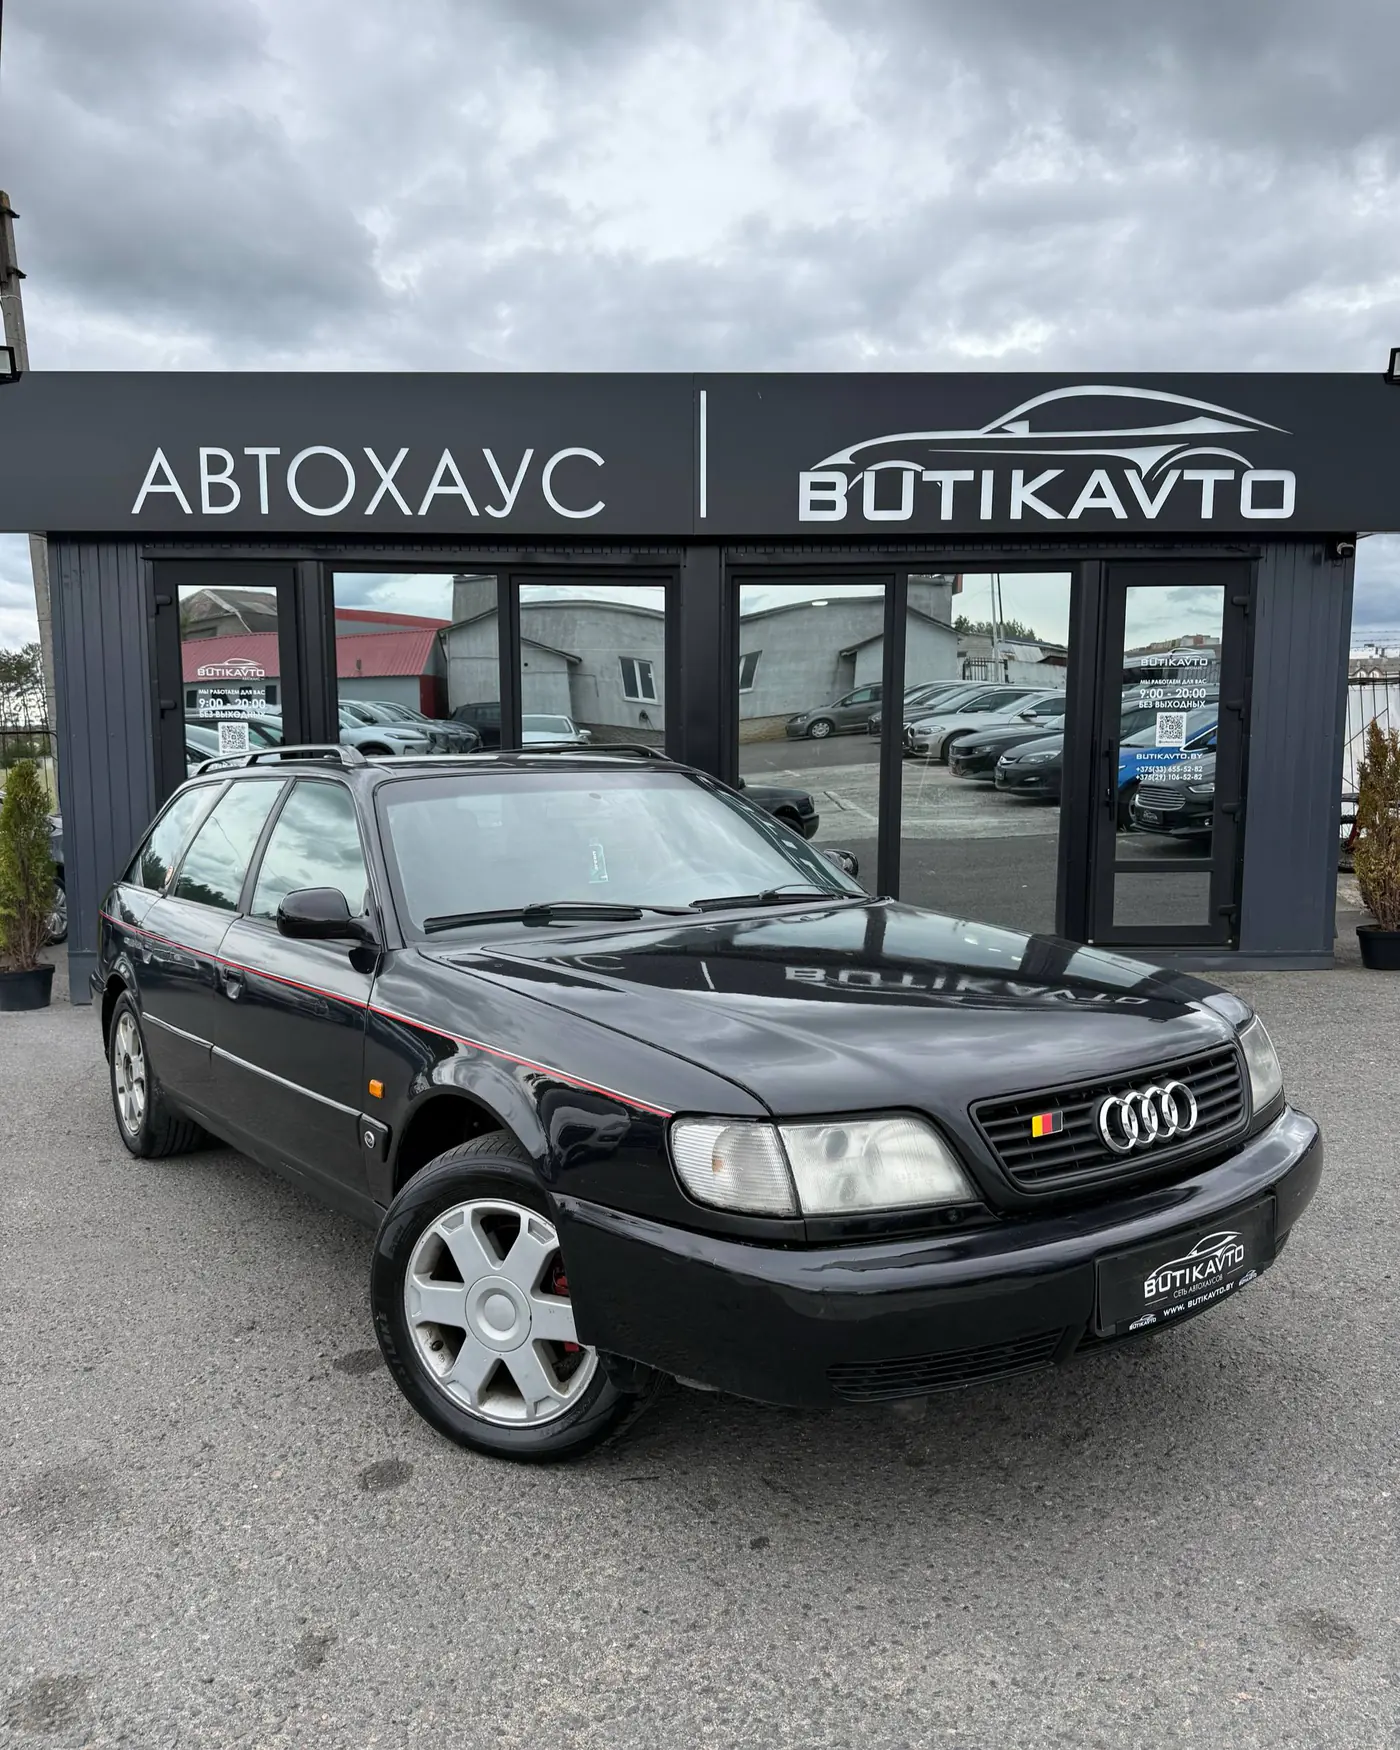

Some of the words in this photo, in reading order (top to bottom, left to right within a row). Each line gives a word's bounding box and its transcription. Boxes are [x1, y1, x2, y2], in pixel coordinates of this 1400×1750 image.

[131, 446, 606, 520] АВТОХАУС
[798, 468, 1297, 522] BUTIKAVTO
[1140, 657, 1208, 667] BUTIKAVTO
[197, 668, 265, 677] BUTIKAVTO
[1140, 688, 1163, 698] 9:00
[1175, 688, 1206, 698] 20:00
[199, 698, 223, 708] 9:00
[234, 698, 266, 709] 20:00
[1155, 700, 1206, 708] ВЫХОДНЫХ
[199, 710, 213, 718] БЕЗ
[1144, 1244, 1244, 1299] BUTIKAVTO
[1173, 1289, 1188, 1299] СЕТЬ
[1188, 1273, 1224, 1294] АВТОХАУСОВ
[1187, 1280, 1235, 1309] BUTIKAVTO.BY
